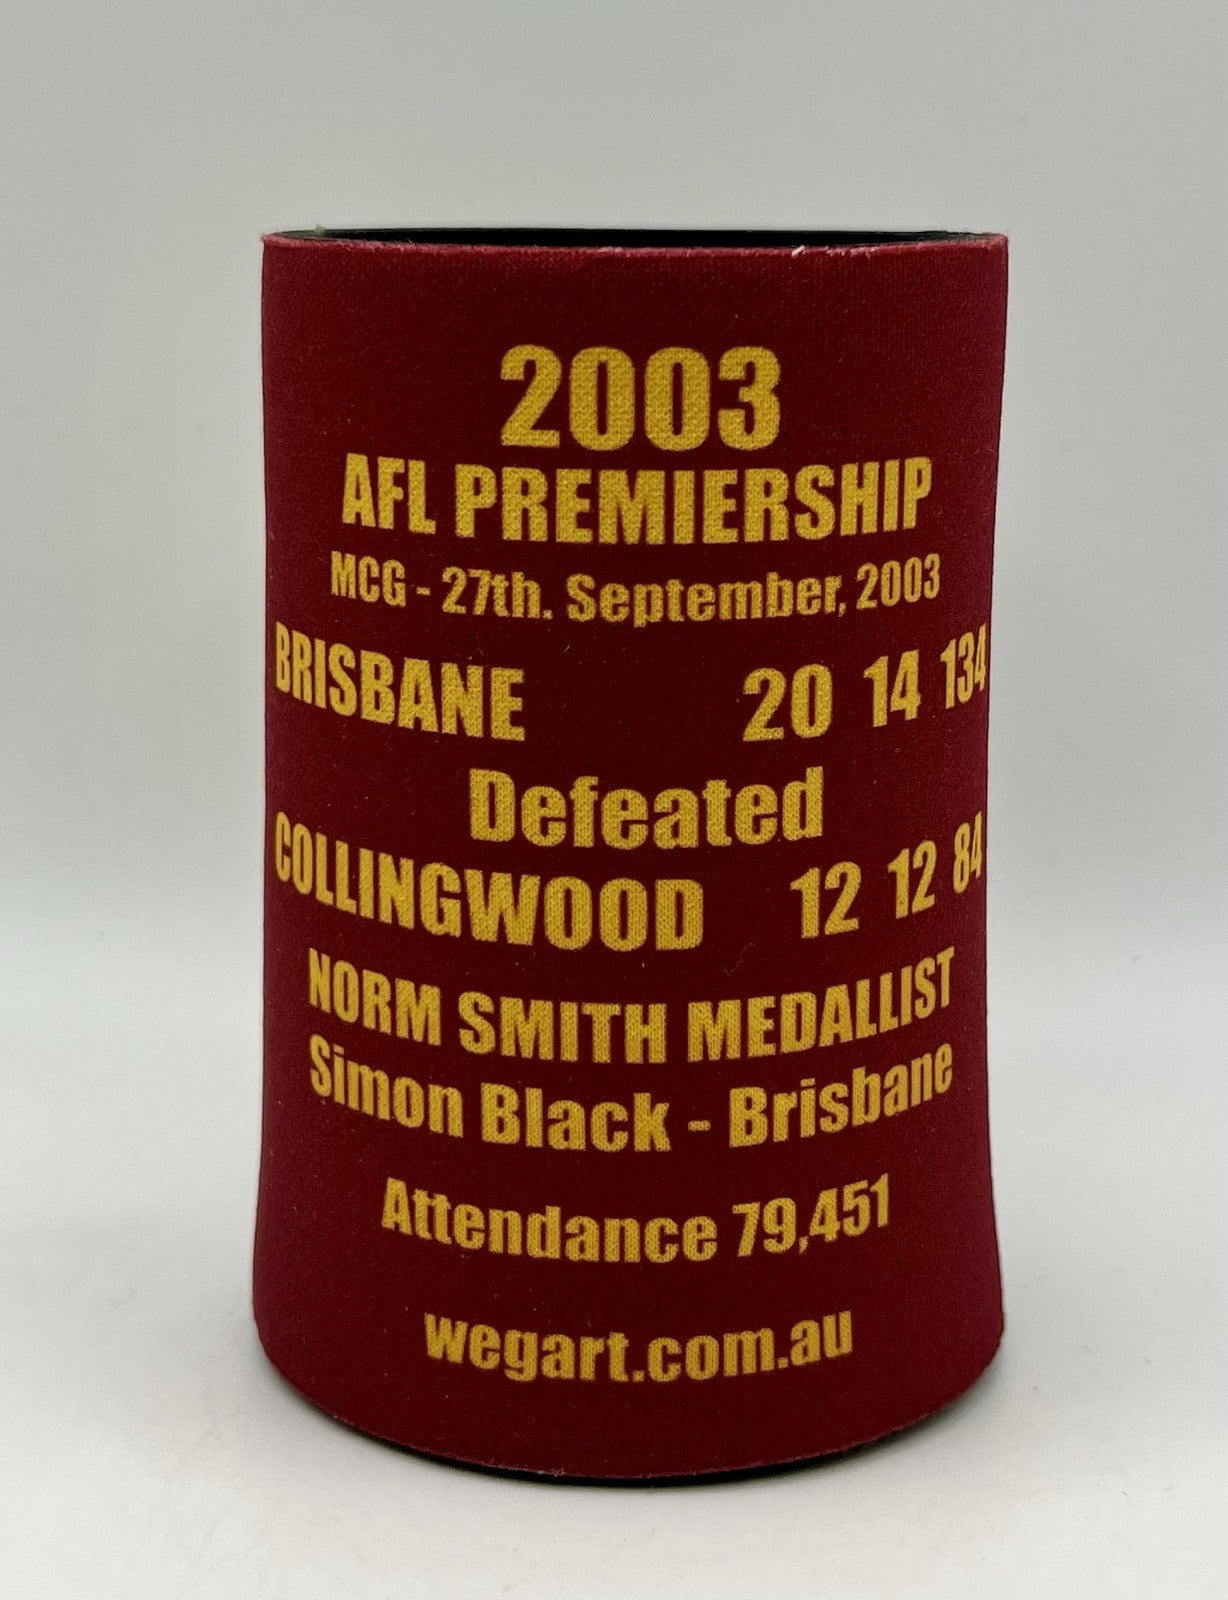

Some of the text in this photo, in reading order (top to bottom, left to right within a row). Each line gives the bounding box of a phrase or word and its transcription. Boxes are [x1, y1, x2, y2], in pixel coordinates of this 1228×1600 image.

[501, 345, 781, 450] 2003
[342, 453, 932, 544] AFL PREMIERSHIP
[331, 551, 940, 628] MCG - 27th. September, 2003
[276, 622, 987, 742] BRISBANE 20 14 134
[470, 767, 824, 850] Defeated
[275, 811, 983, 952] COLLINGWOOD 12 12 84
[309, 947, 954, 1064] NORM SMITH MEDALLIST
[310, 1035, 953, 1152] Simon Black - Brisbane
[382, 1175, 890, 1263] Attendance 79,451
[425, 1312, 852, 1382] wegart.com.au
